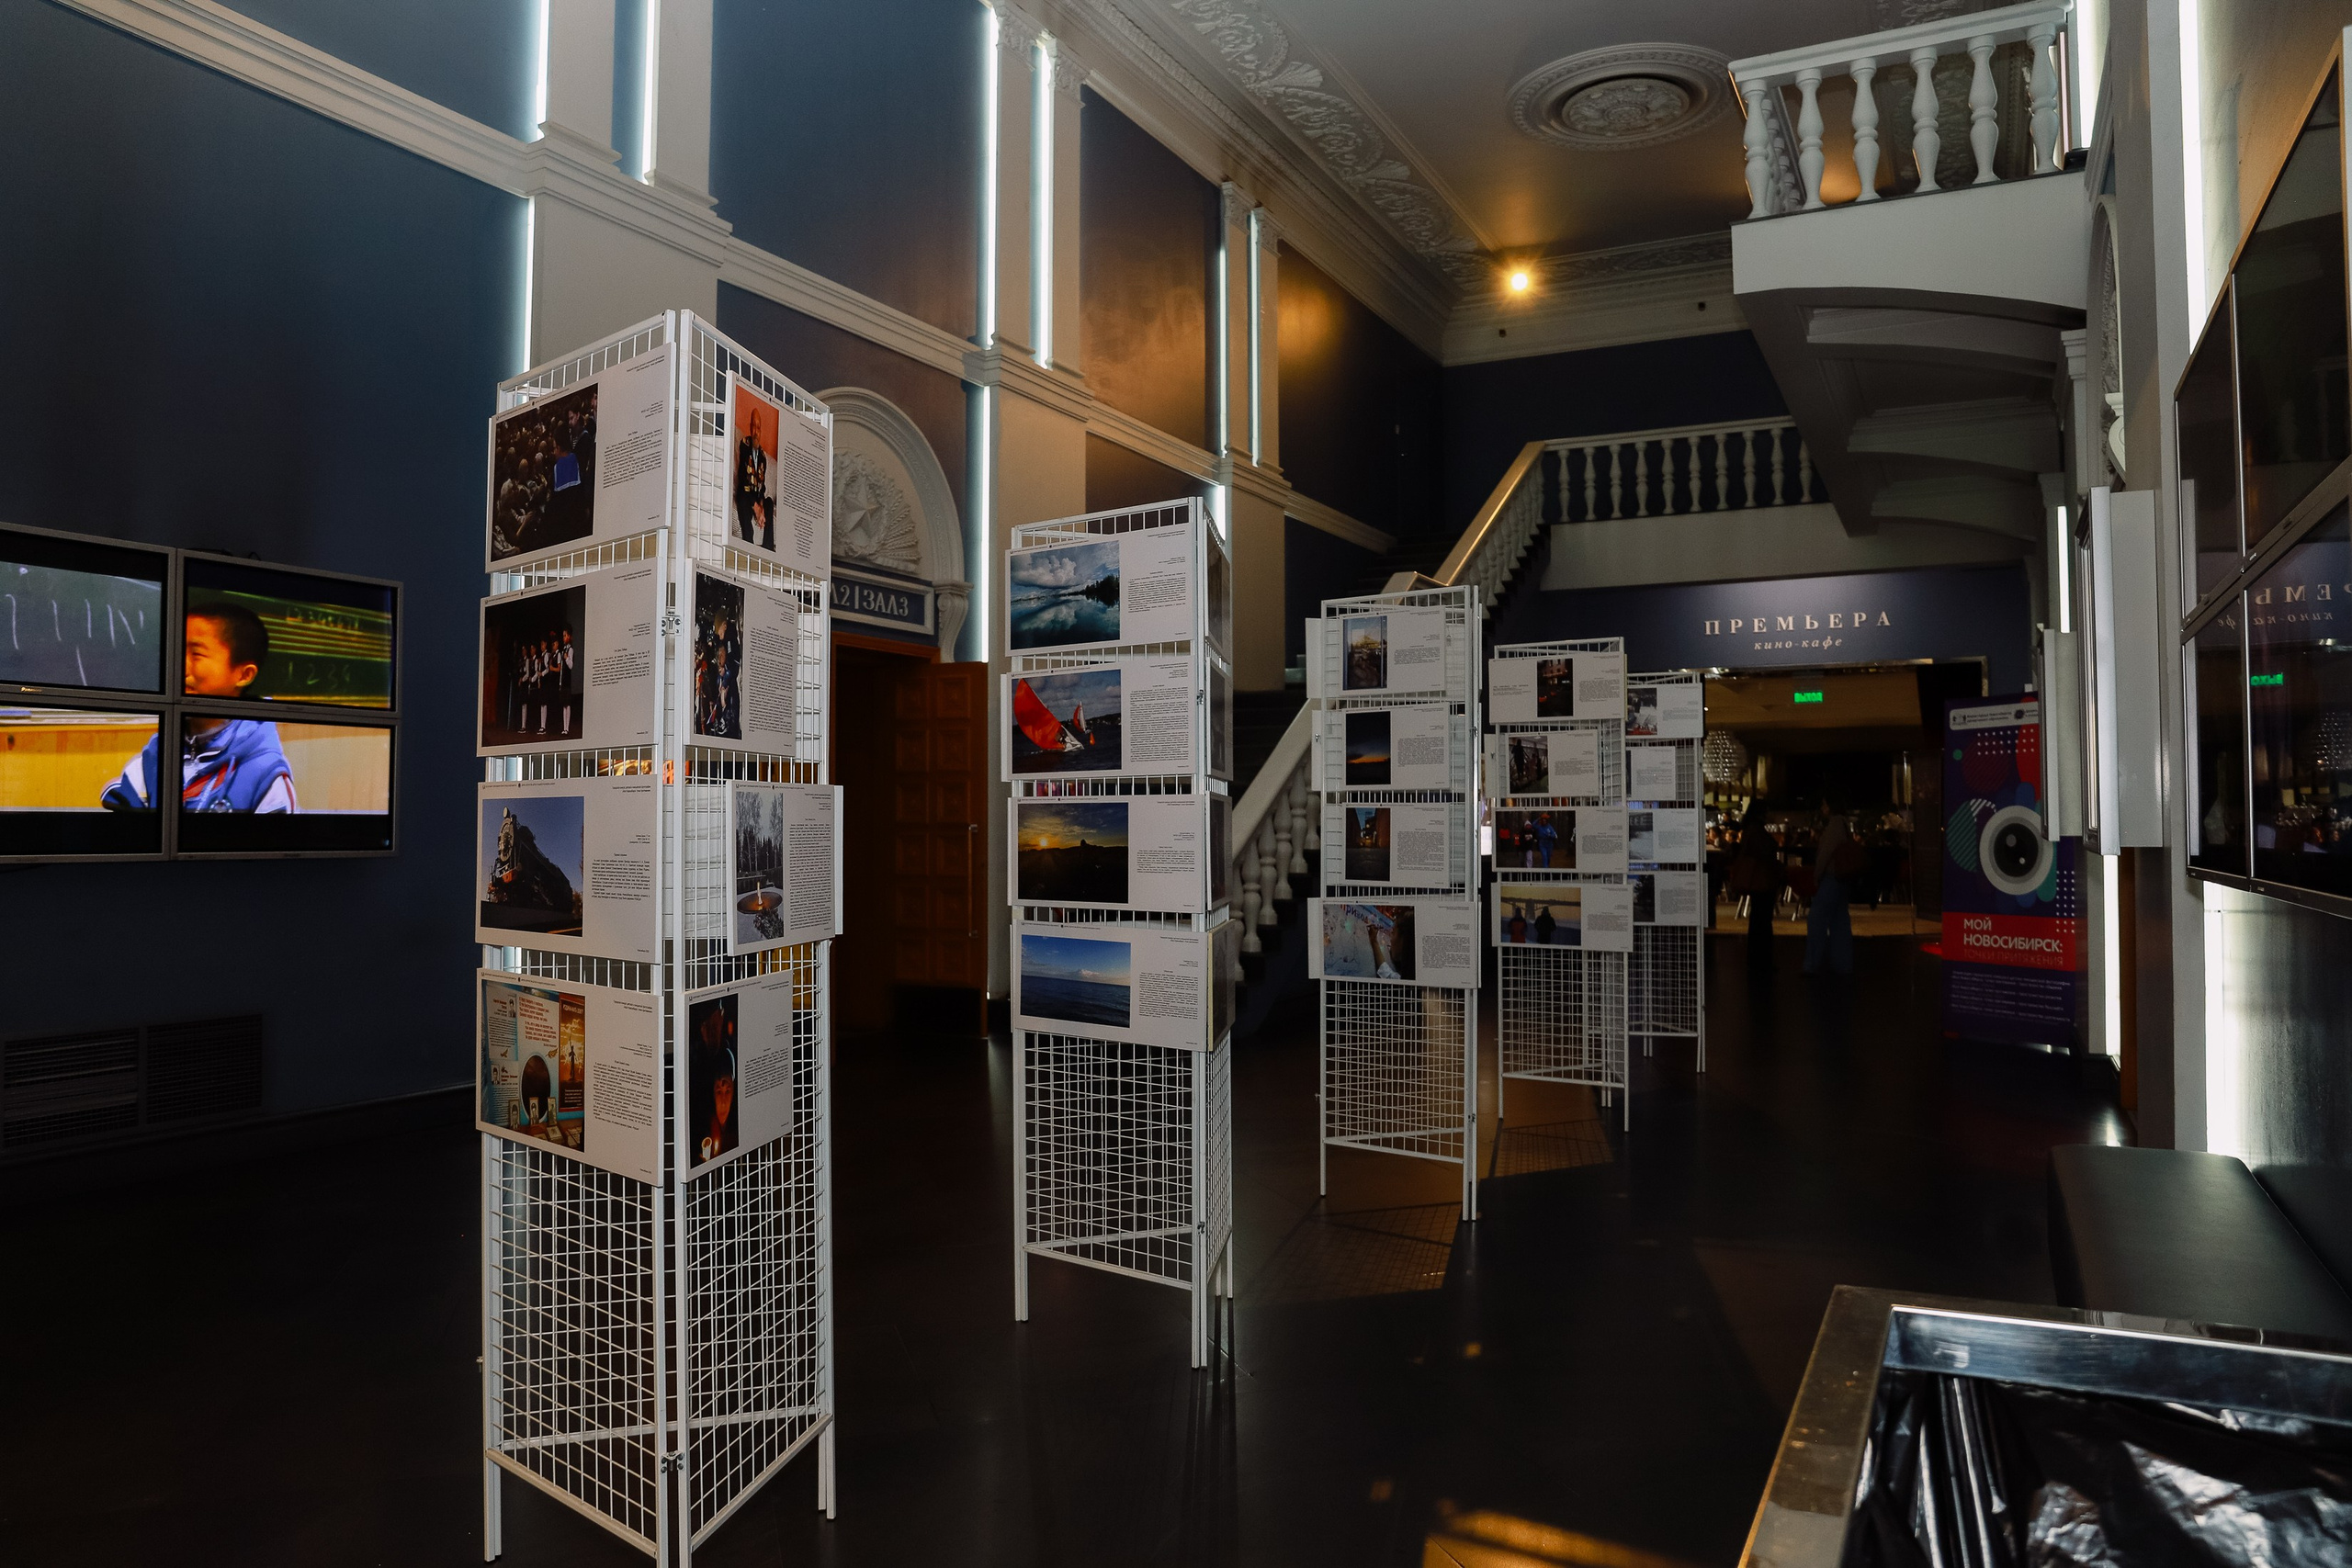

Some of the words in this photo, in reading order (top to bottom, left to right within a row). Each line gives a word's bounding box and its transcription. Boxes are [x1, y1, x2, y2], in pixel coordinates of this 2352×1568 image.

[1704, 611, 1891, 636] ПРЕМЬЕРА
[1754, 636, 1843, 650] кино-кафе
[1963, 917, 1992, 931] МОЙ
[1963, 933, 2064, 953] НОВОСИБИРСК:
